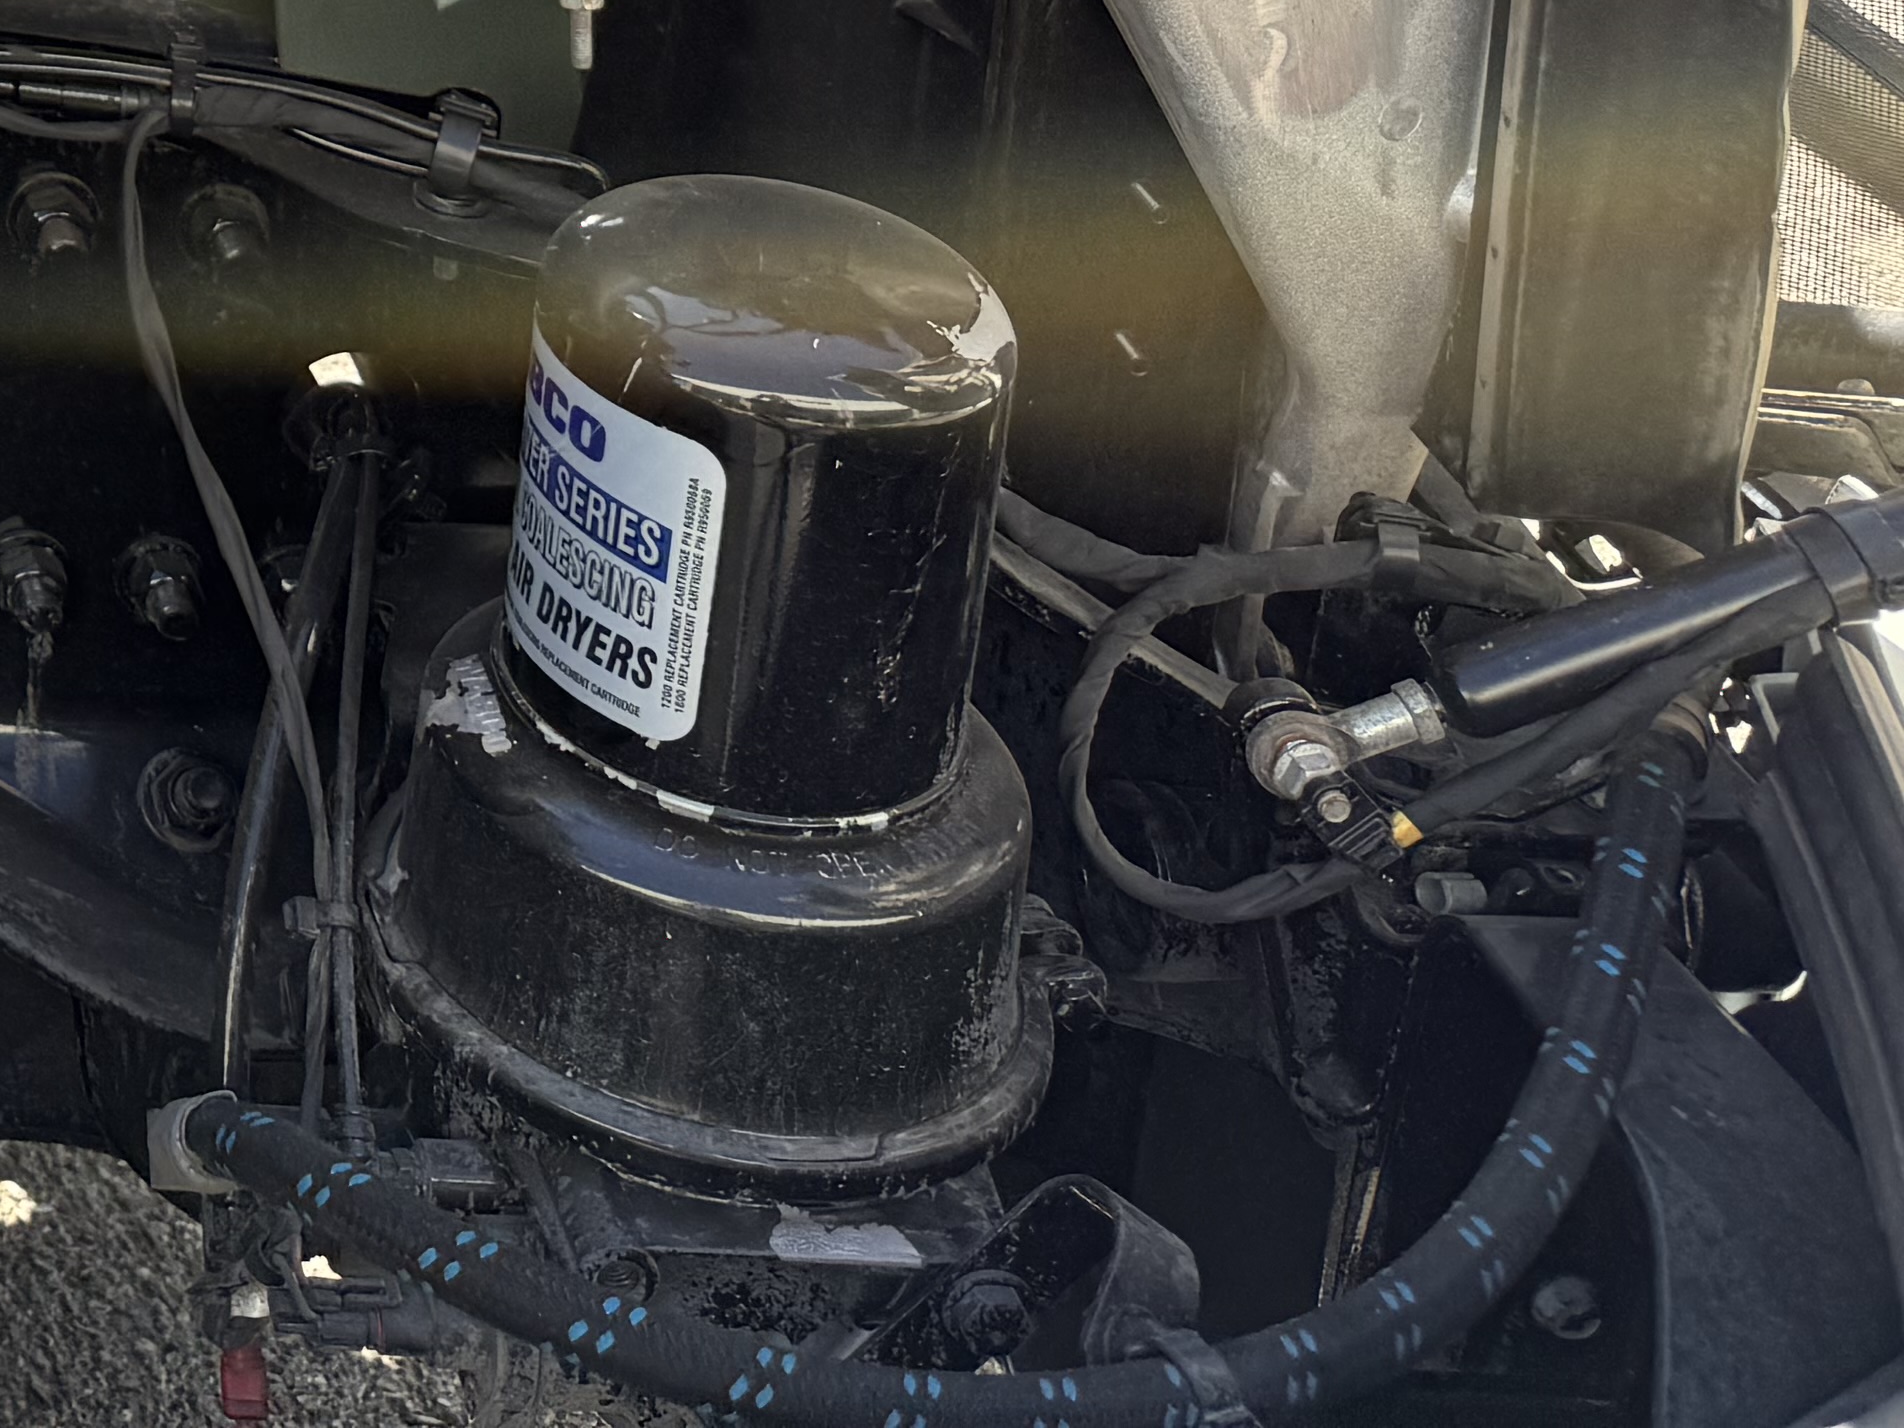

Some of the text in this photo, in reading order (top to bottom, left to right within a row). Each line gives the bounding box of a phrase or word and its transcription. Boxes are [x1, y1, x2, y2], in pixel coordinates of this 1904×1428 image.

[554, 464, 662, 567] SERIES
[681, 534, 691, 547] PN
[695, 538, 706, 552] PN
[521, 493, 656, 631] COALESCING
[676, 548, 693, 607] CARTRIDGE
[687, 553, 705, 611] CARTRIDGE
[508, 539, 659, 690] AIR DRYERS
[664, 606, 684, 686] REPLACEMENT
[679, 611, 697, 689] REPLACEMENT
[541, 642, 591, 691] REPLACEMENT
[590, 682, 642, 718] CARTRIDGE
[661, 683, 672, 710] 1200
